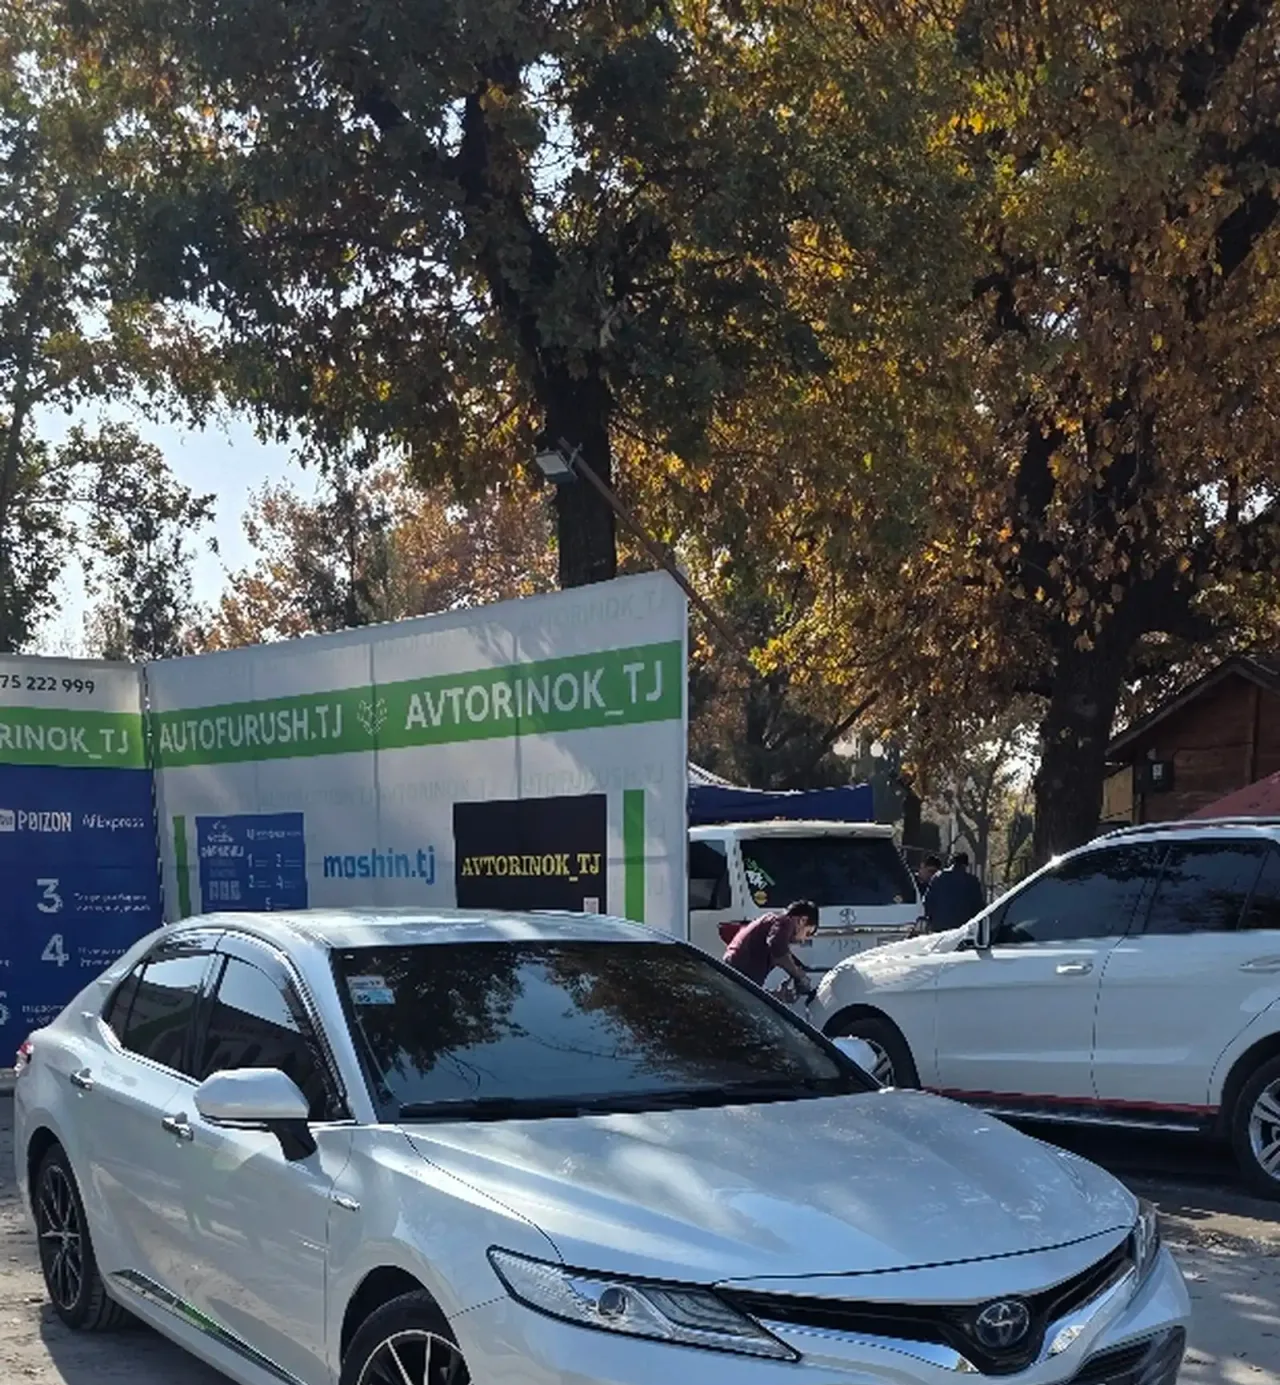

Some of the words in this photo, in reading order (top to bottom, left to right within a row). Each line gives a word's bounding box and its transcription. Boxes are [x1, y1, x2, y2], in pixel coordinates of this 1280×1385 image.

[26, 676, 57, 691] 222
[61, 678, 95, 695] 999
[158, 704, 343, 753] AUTOFURUSH.TJ
[405, 660, 664, 730] AVTORINOK_TJ
[461, 853, 601, 882] AVTORINOK_TJ
[36, 878, 63, 913] 3
[41, 933, 70, 967] 4
